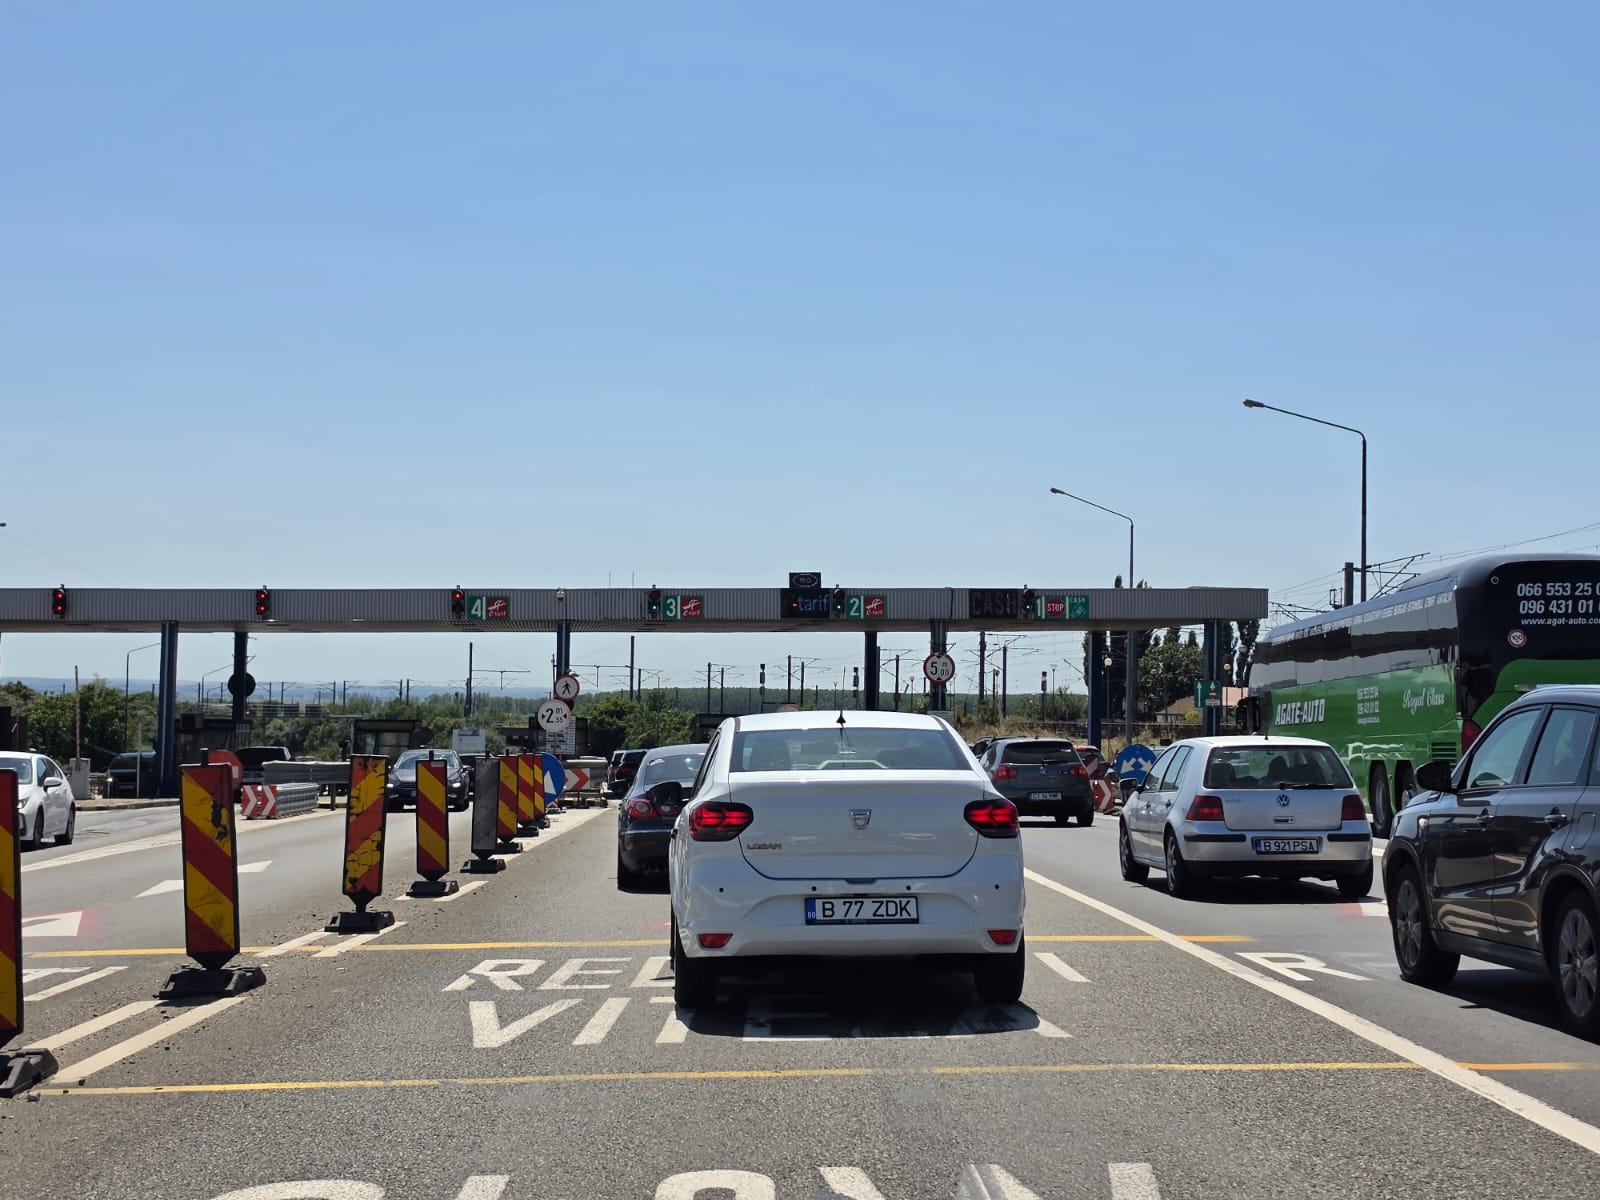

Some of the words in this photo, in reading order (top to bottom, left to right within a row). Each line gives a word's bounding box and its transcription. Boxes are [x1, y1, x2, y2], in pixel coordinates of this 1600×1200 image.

[1517, 583, 1543, 597] 066
[1546, 583, 1571, 596] 553
[1575, 582, 1592, 596] 25
[471, 599, 481, 618] 4
[666, 598, 676, 617] 3
[849, 597, 860, 616] 2
[1047, 604, 1064, 612] STOP
[1520, 600, 1545, 614] 096
[1549, 600, 1572, 613] 431
[1578, 600, 1593, 613] 01
[931, 661, 937, 675] 5
[1403, 688, 1425, 714] Royal
[546, 708, 553, 723] 2
[1264, 841, 1271, 851] B
[1274, 841, 1290, 851] 921
[1293, 841, 1314, 851] PSA
[822, 902, 835, 918] B
[842, 901, 864, 918] 77
[872, 900, 911, 917] ZDK
